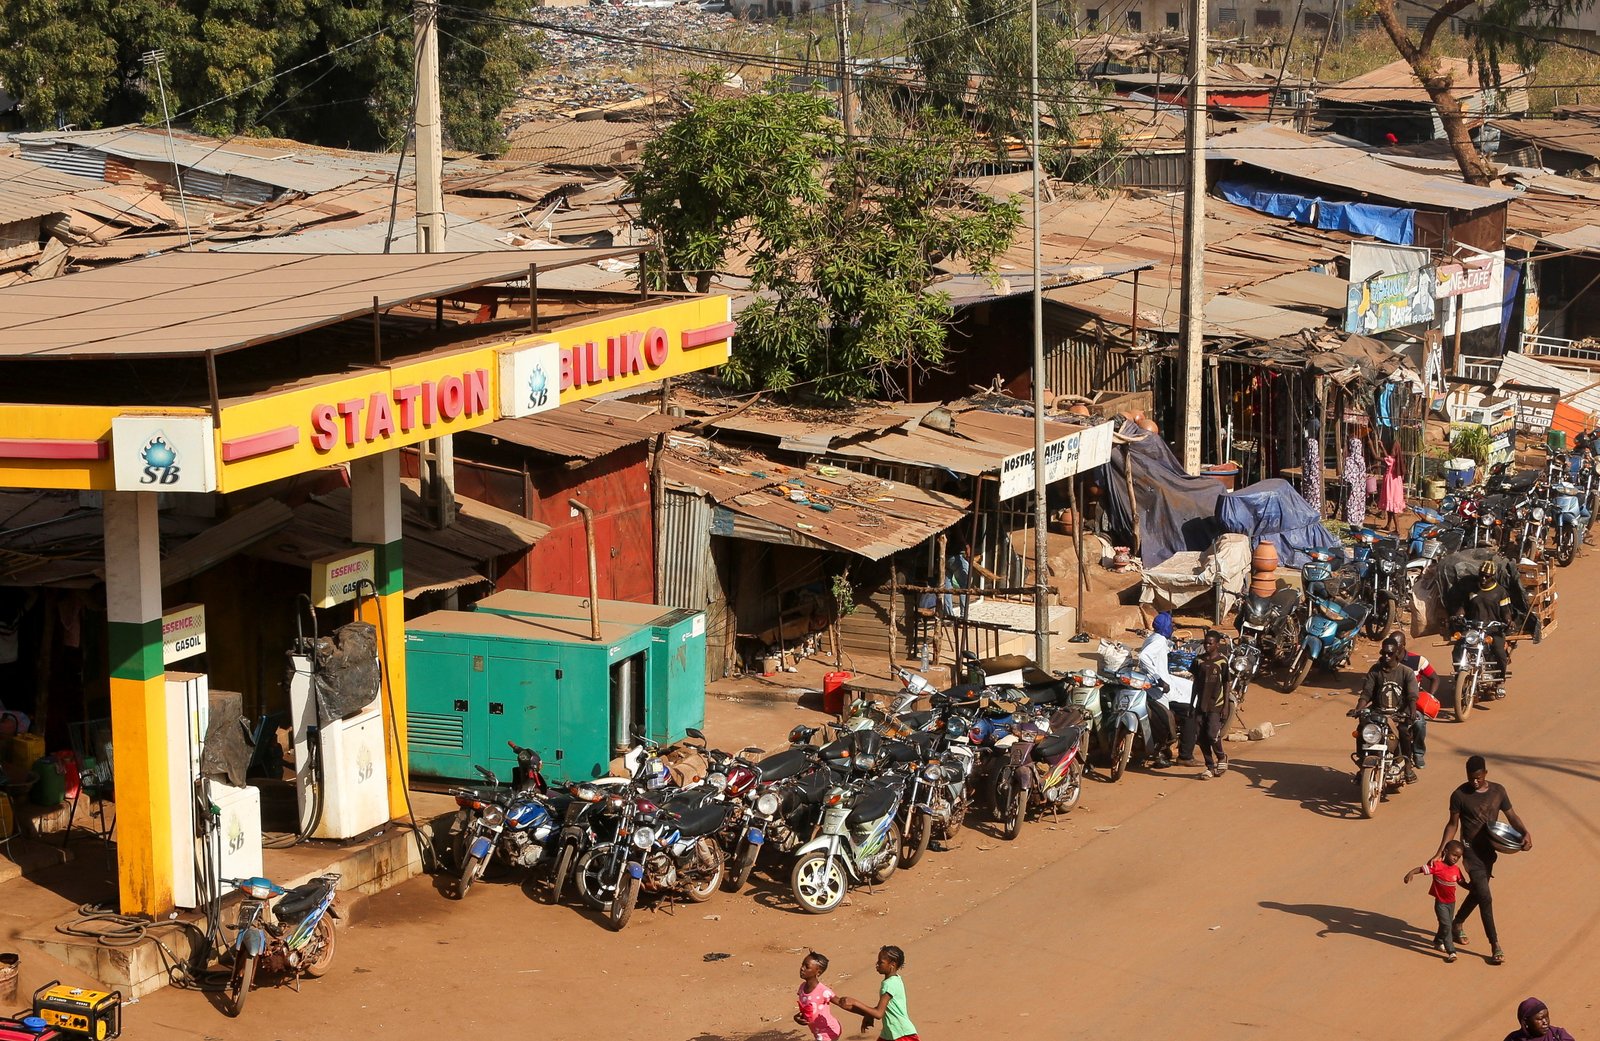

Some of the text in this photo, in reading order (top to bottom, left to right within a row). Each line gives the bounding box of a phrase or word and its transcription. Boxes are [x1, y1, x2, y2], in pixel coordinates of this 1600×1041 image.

[311, 327, 669, 452] STATION BILIKO
[527, 388, 548, 409] SB
[1004, 440, 1065, 473] NOSTRAAMIS
[140, 465, 181, 485] SB
[331, 561, 361, 578] ESSENCE
[342, 580, 369, 594] GASIL
[175, 634, 202, 652] GASOIL
[358, 762, 373, 784] SB
[228, 832, 244, 855] SB
